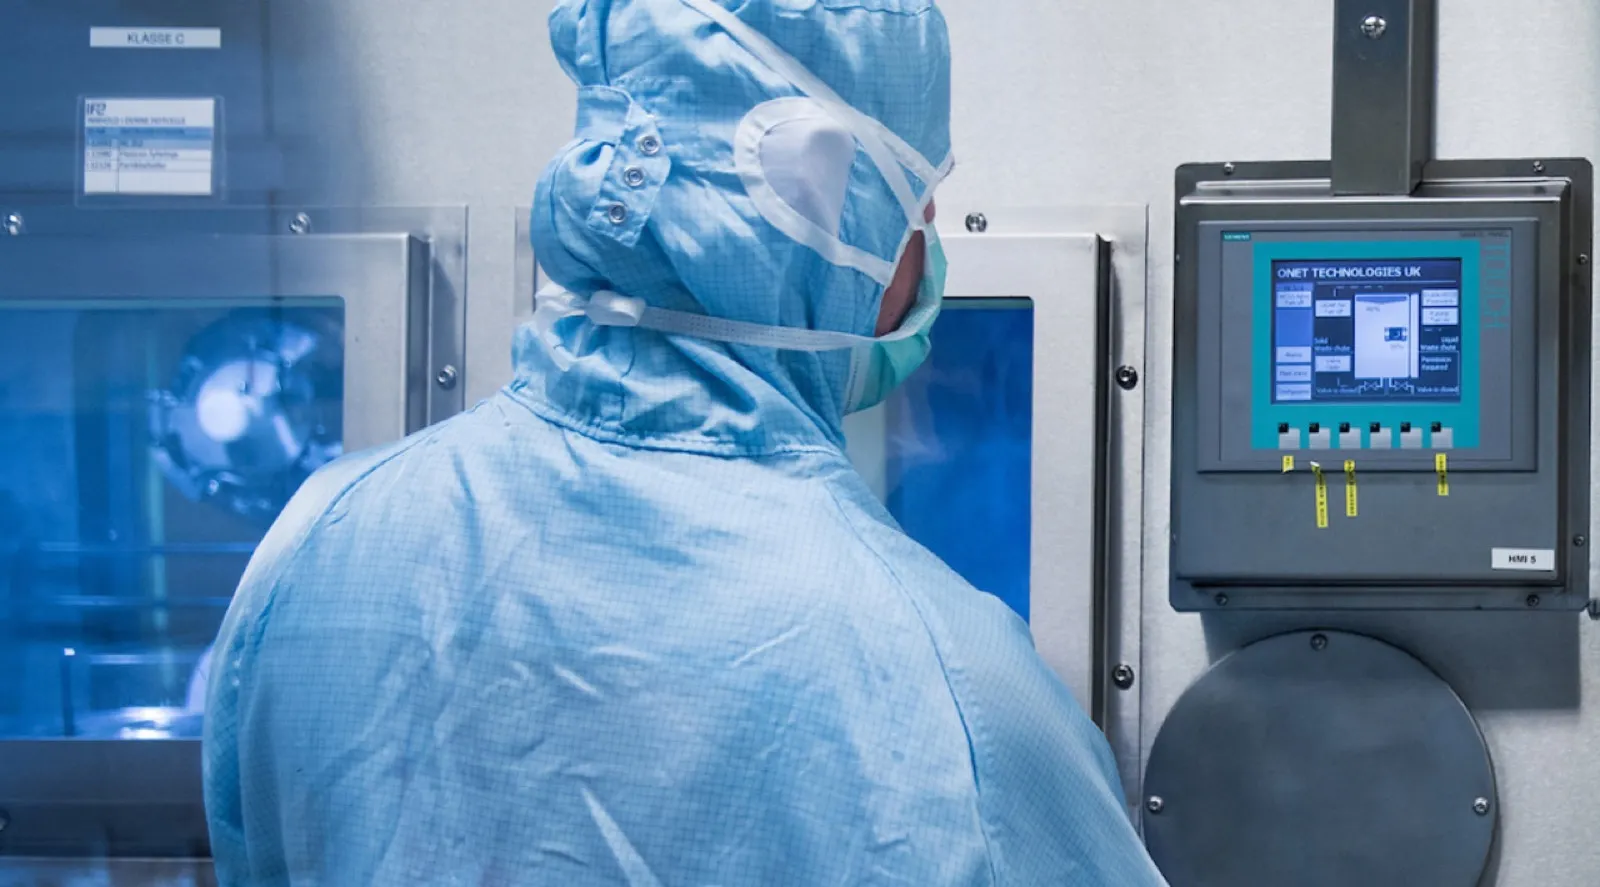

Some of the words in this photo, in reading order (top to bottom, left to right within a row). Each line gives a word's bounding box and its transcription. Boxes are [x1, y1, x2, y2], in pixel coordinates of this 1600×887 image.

[126, 32, 173, 45] KLASSE
[175, 32, 185, 45] C
[1277, 268, 1309, 278] ONET
[1313, 267, 1402, 278] TECHNOLOGIES
[1404, 266, 1421, 277] UK
[1508, 554, 1528, 564] HMI
